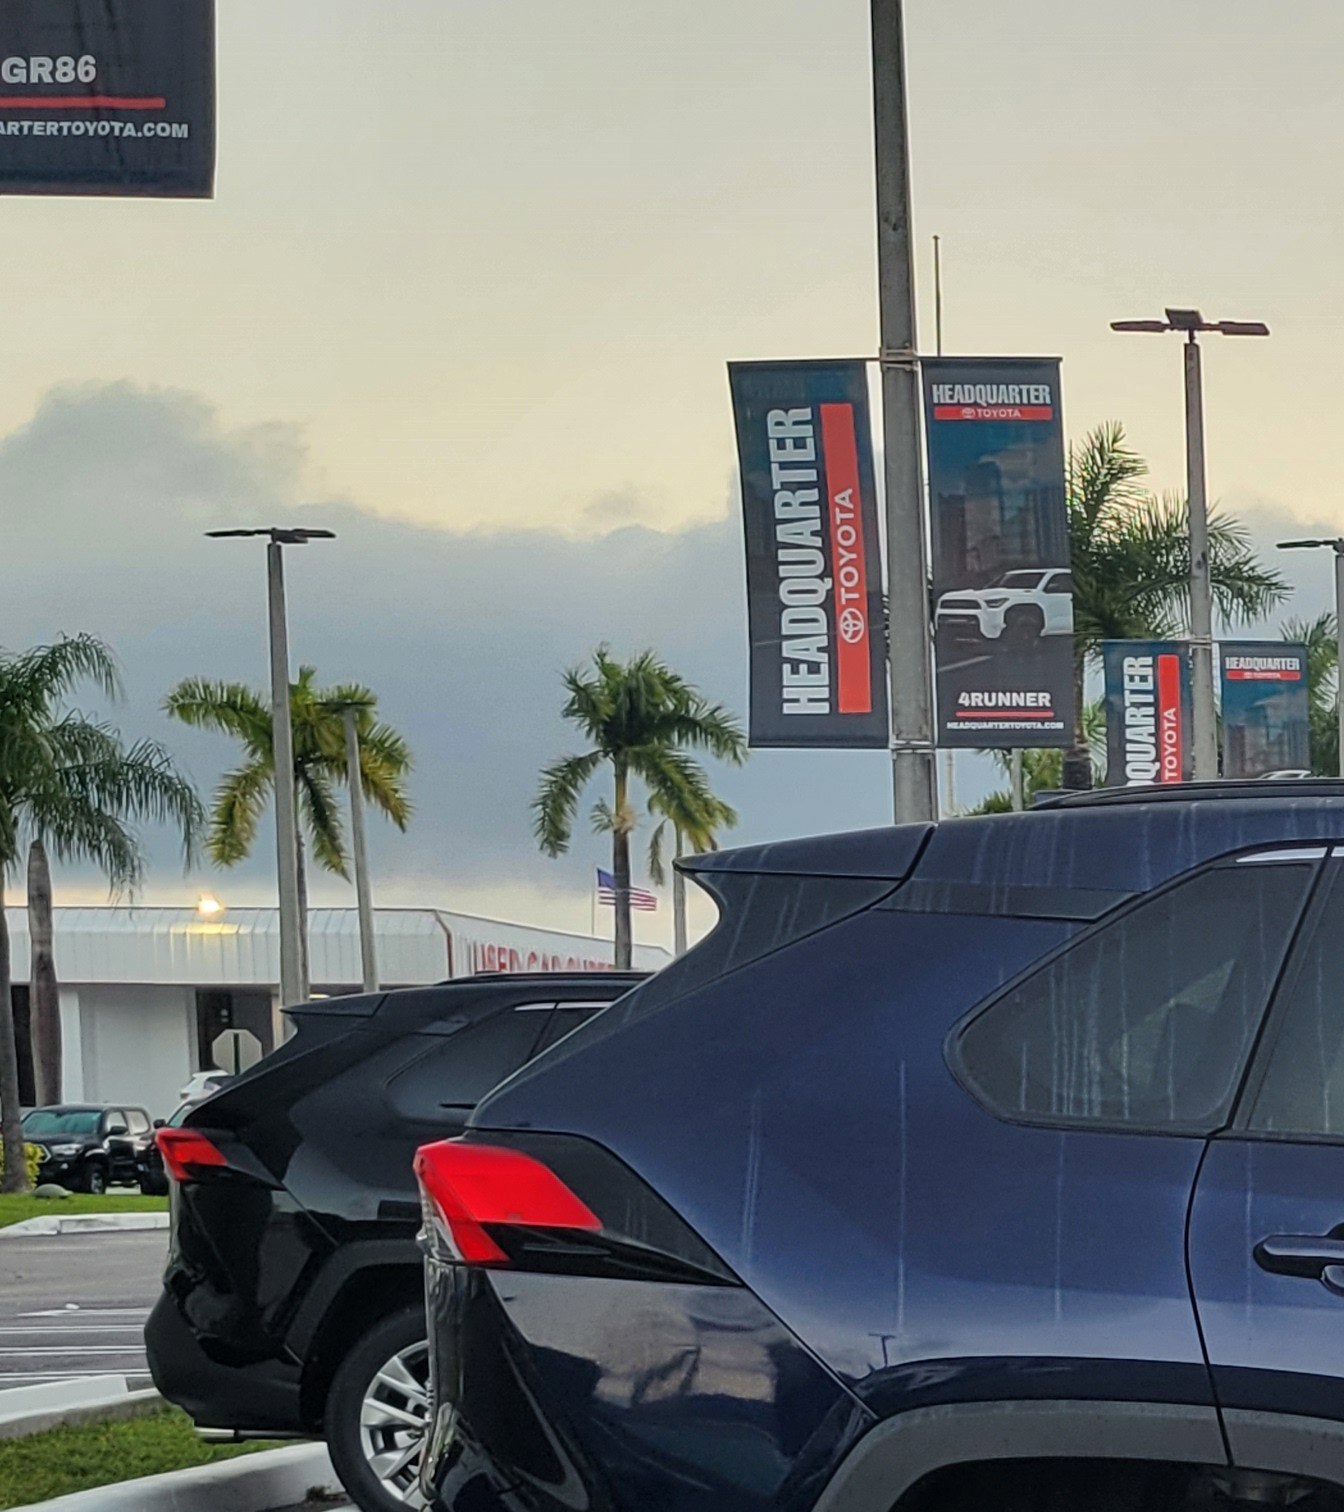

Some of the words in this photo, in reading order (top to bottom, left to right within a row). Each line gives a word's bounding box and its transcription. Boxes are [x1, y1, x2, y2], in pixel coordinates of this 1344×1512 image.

[2, 54, 97, 84] GR86
[0, 120, 190, 139] RTERTOYOTA.COM
[932, 383, 1052, 407] HEADQUARTER
[977, 407, 1022, 418] TOYOTA
[767, 405, 833, 715] HEADQUARTER
[835, 488, 861, 605] TOYOTA
[1225, 656, 1300, 672] HEADQUARTER
[958, 691, 1052, 708] 4RUNNER
[1123, 655, 1161, 787] QUARTER
[1162, 707, 1179, 780] TOYOTA
